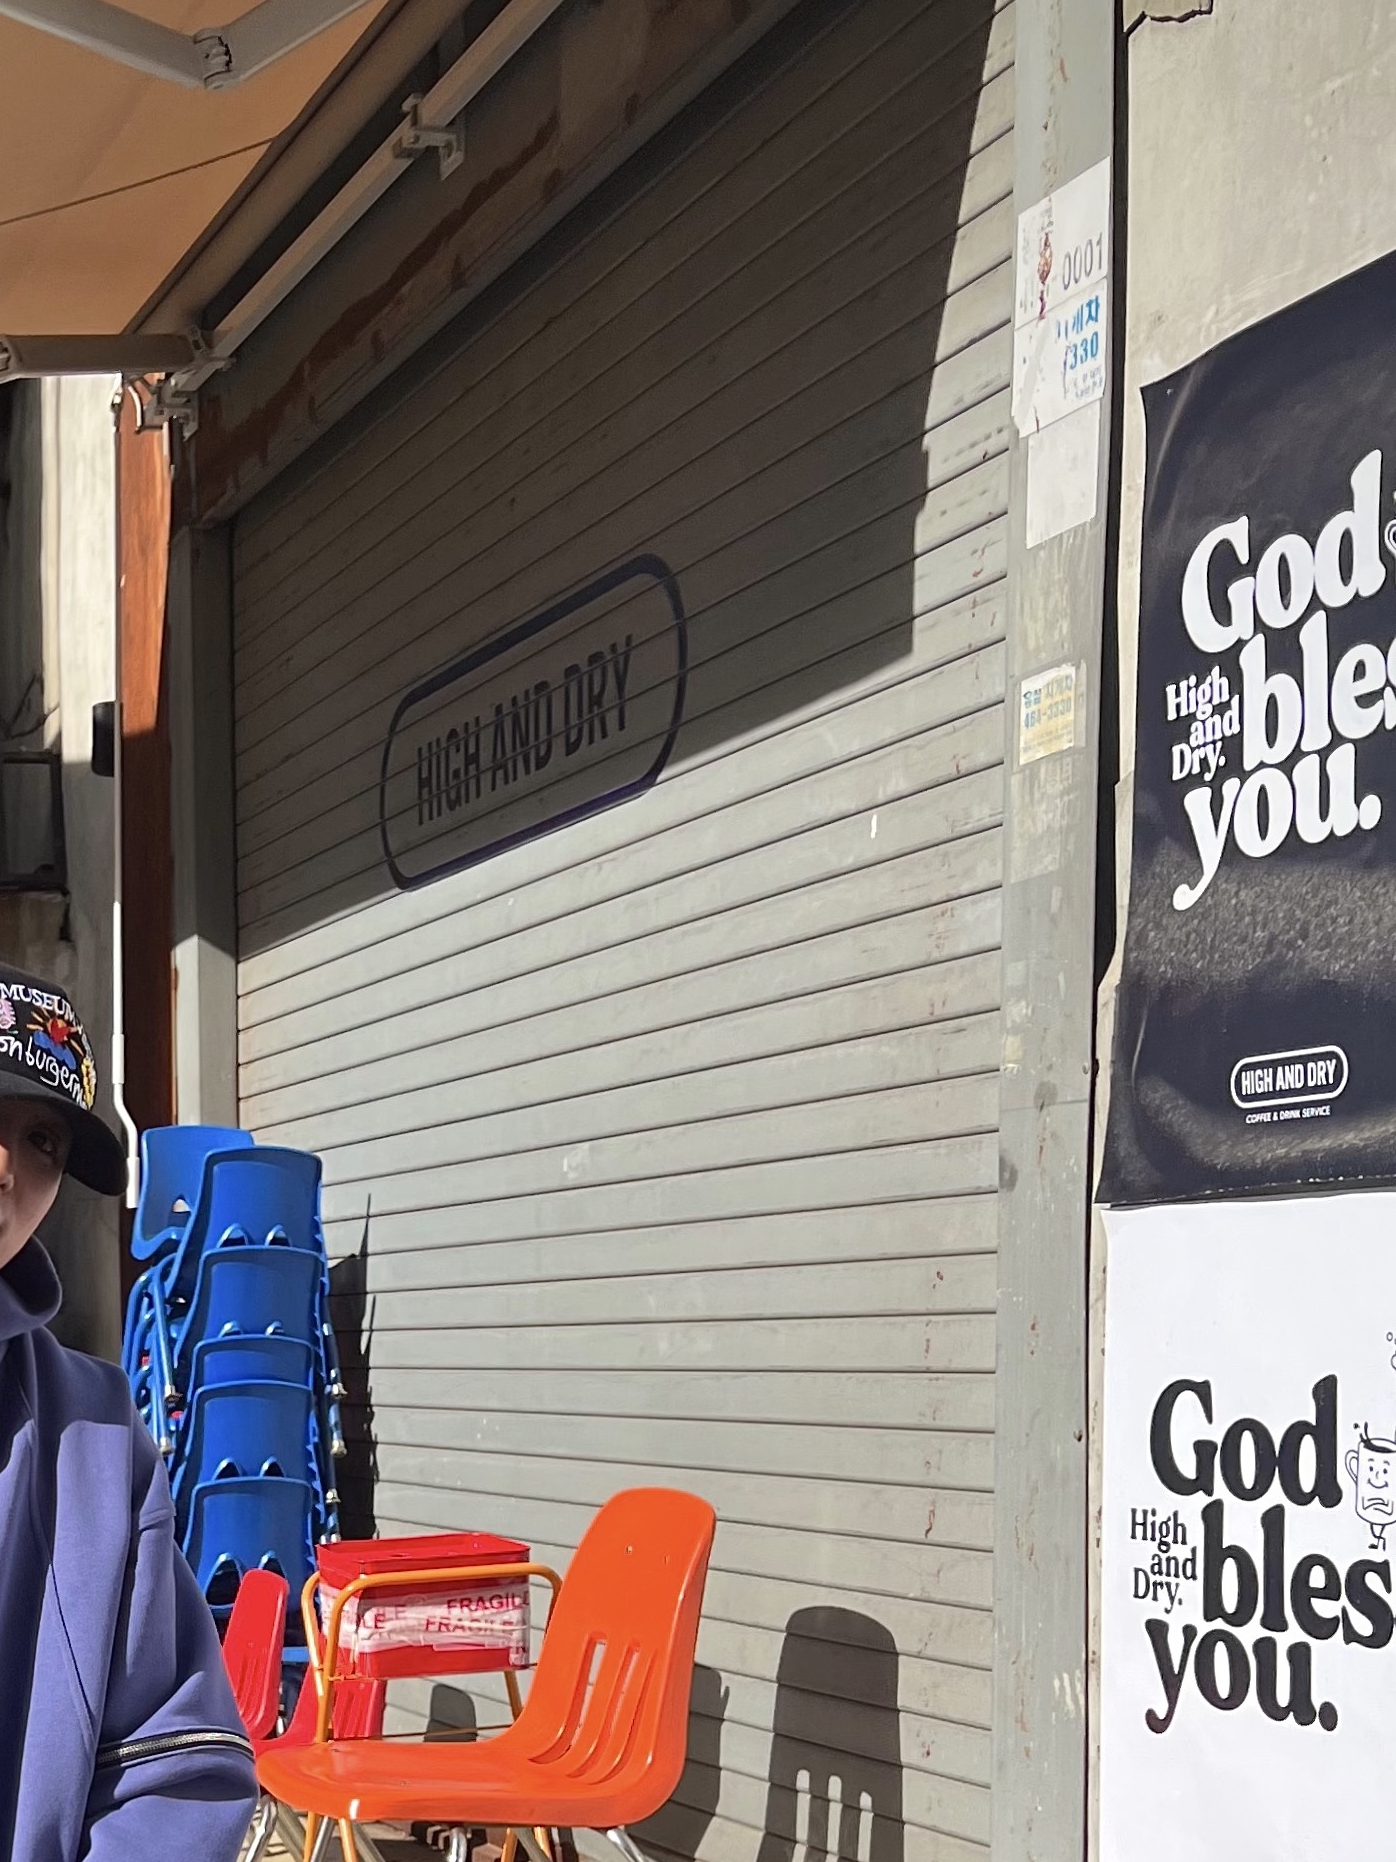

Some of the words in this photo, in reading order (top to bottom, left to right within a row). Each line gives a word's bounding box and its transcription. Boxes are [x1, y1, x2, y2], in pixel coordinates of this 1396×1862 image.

[1062, 232, 1103, 291] 0001
[1182, 449, 1387, 653] God
[1166, 665, 1230, 720] High
[417, 716, 481, 826] HIGH
[491, 680, 553, 793] AND
[564, 634, 634, 758] DRY
[1190, 695, 1241, 748] and
[1172, 740, 1225, 781] Dry.
[1173, 742, 1381, 911] you.
[0, 983, 77, 1026] MUSEUM
[1241, 1068, 1273, 1095] HIGH
[1275, 1064, 1304, 1092] AND
[1307, 1059, 1337, 1087] DRY
[1245, 1111, 1272, 1124] COFFEE
[1279, 1109, 1301, 1121] DRINK
[1302, 1105, 1331, 1118] SERVICE
[1150, 1374, 1343, 1508] God
[1130, 1507, 1188, 1554] High
[1132, 1567, 1183, 1614] Dry.
[1150, 1546, 1198, 1581] and
[1201, 1498, 1396, 1650] bles
[1144, 1618, 1338, 1735] you.
